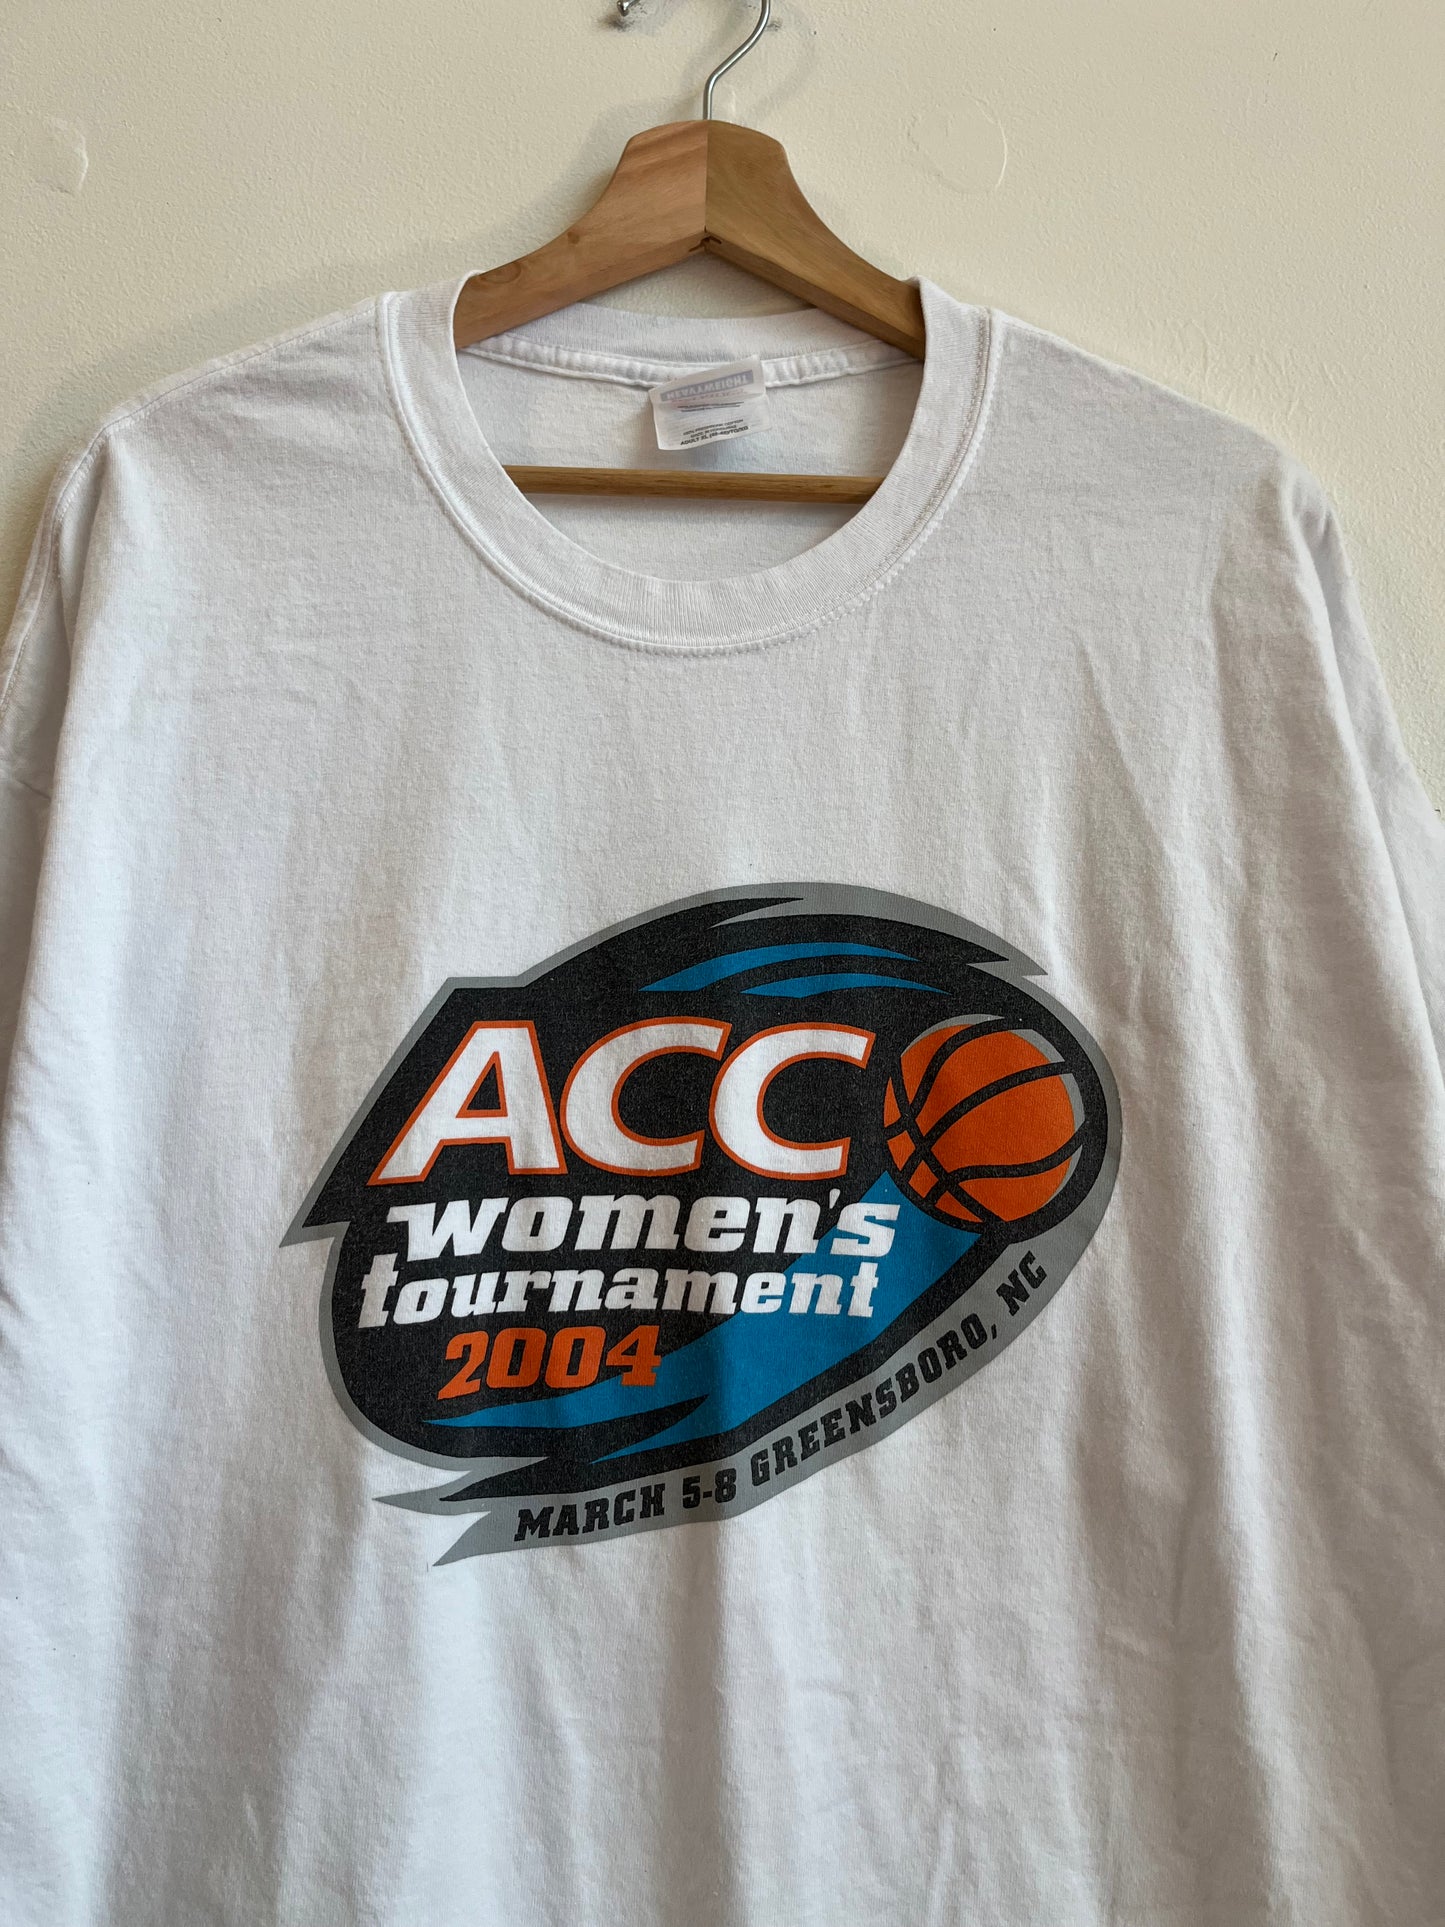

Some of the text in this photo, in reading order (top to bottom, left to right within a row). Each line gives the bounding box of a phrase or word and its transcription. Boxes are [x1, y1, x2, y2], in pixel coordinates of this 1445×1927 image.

[366, 1016, 876, 1186] ACC
[386, 1188, 900, 1262] women's
[358, 1253, 878, 1329] tournament
[438, 1325, 661, 1400] 2004
[514, 1251, 1047, 1541] MARCH 5-8 GREENSBORO, NC
